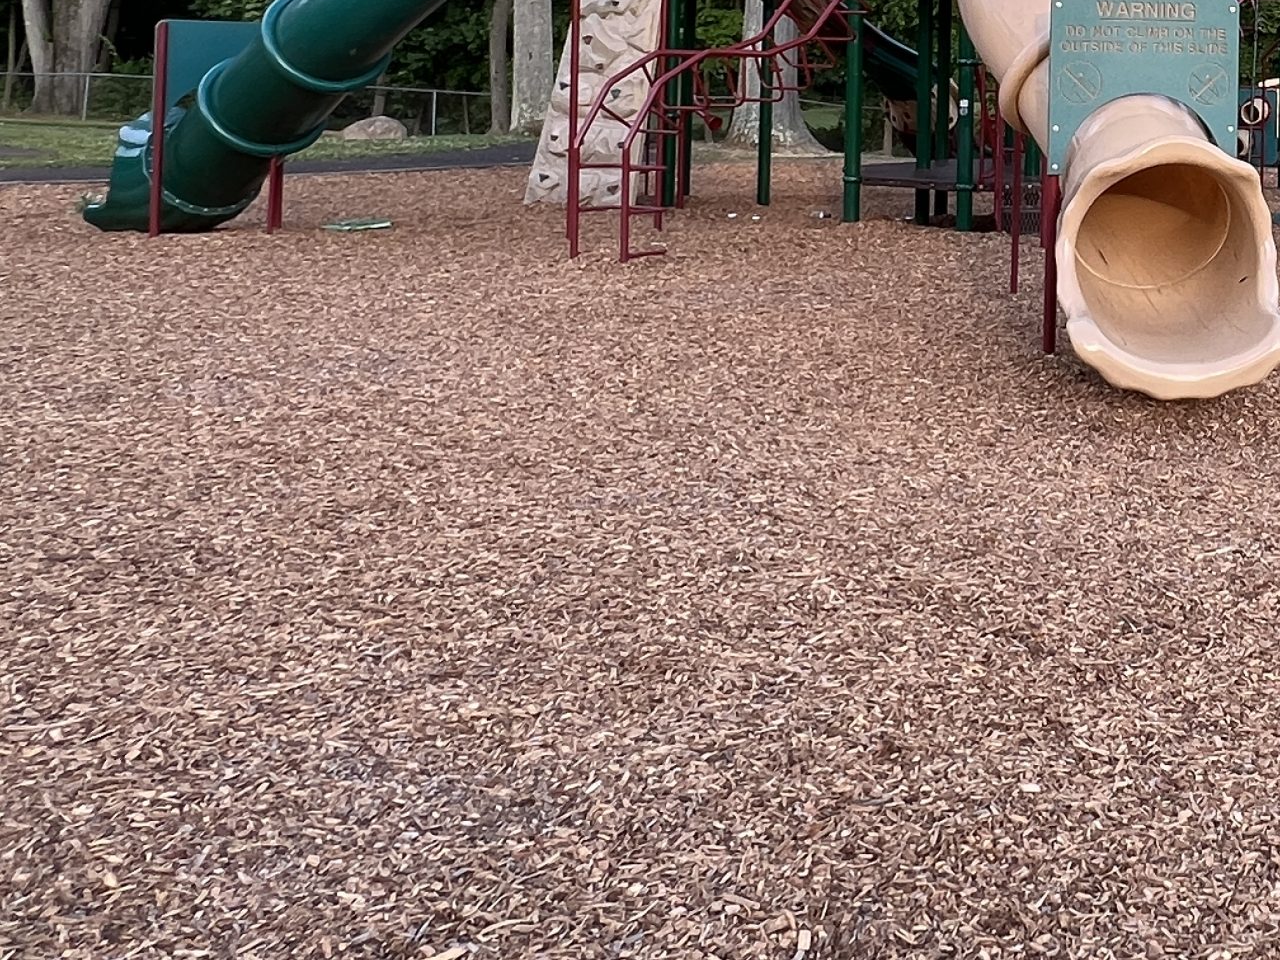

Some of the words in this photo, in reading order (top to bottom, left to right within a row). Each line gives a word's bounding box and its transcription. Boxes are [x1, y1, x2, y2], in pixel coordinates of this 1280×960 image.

[1096, 0, 1196, 19] WARNING
[1065, 24, 1086, 37] DO
[1091, 25, 1121, 38] NOT
[1173, 27, 1194, 40] ON
[1200, 28, 1227, 41] THE
[1061, 40, 1123, 53] OUTSIDE
[1129, 41, 1148, 53] OF
[1152, 42, 1183, 54] THIS
[1188, 42, 1228, 54] SLIDE
